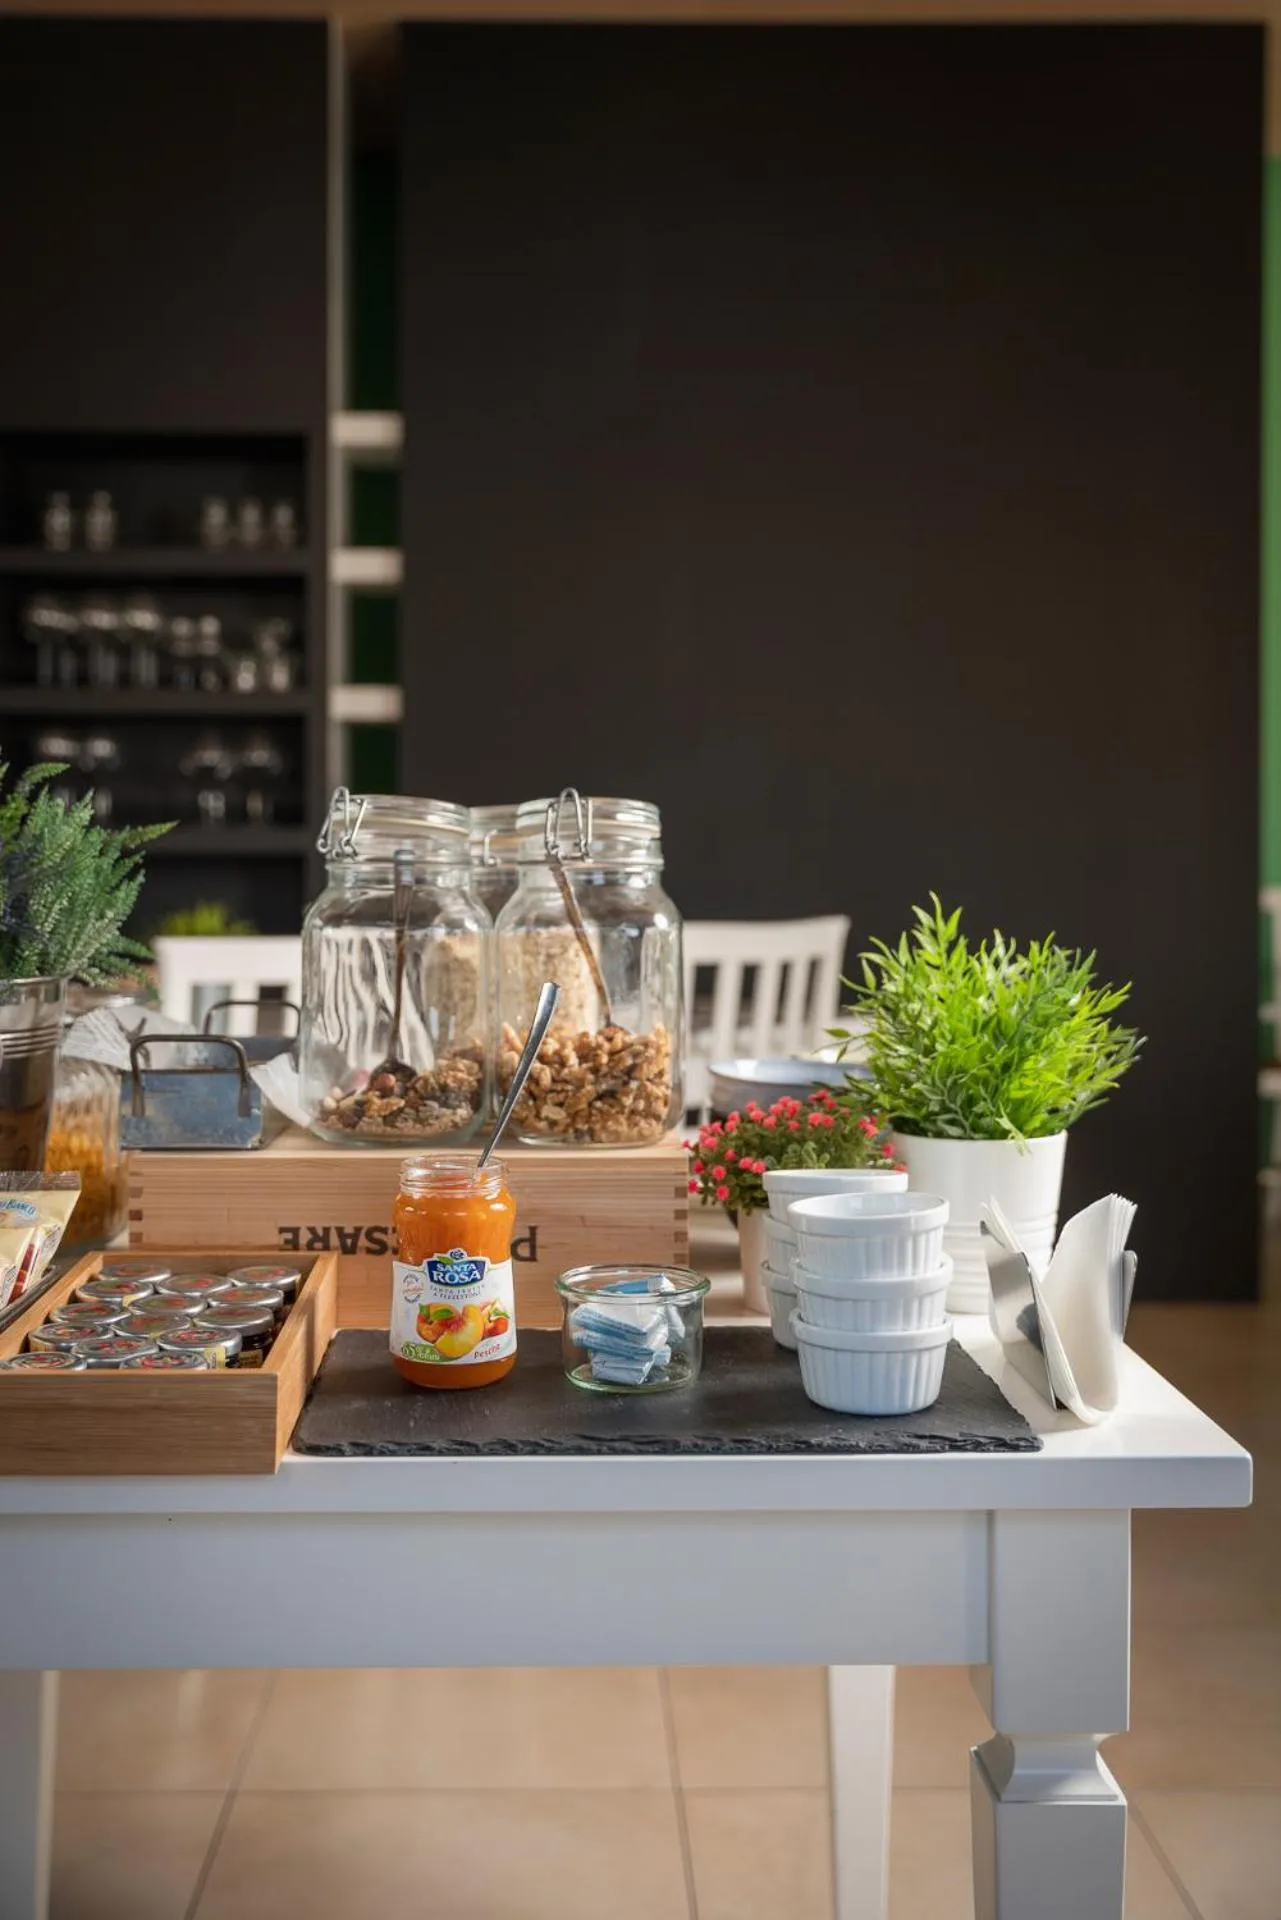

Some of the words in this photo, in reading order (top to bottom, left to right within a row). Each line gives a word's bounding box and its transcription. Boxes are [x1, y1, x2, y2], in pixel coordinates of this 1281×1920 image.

[278, 1225, 399, 1256] SARE
[436, 1263, 477, 1272] SANTA
[432, 1270, 481, 1284] ROSA
